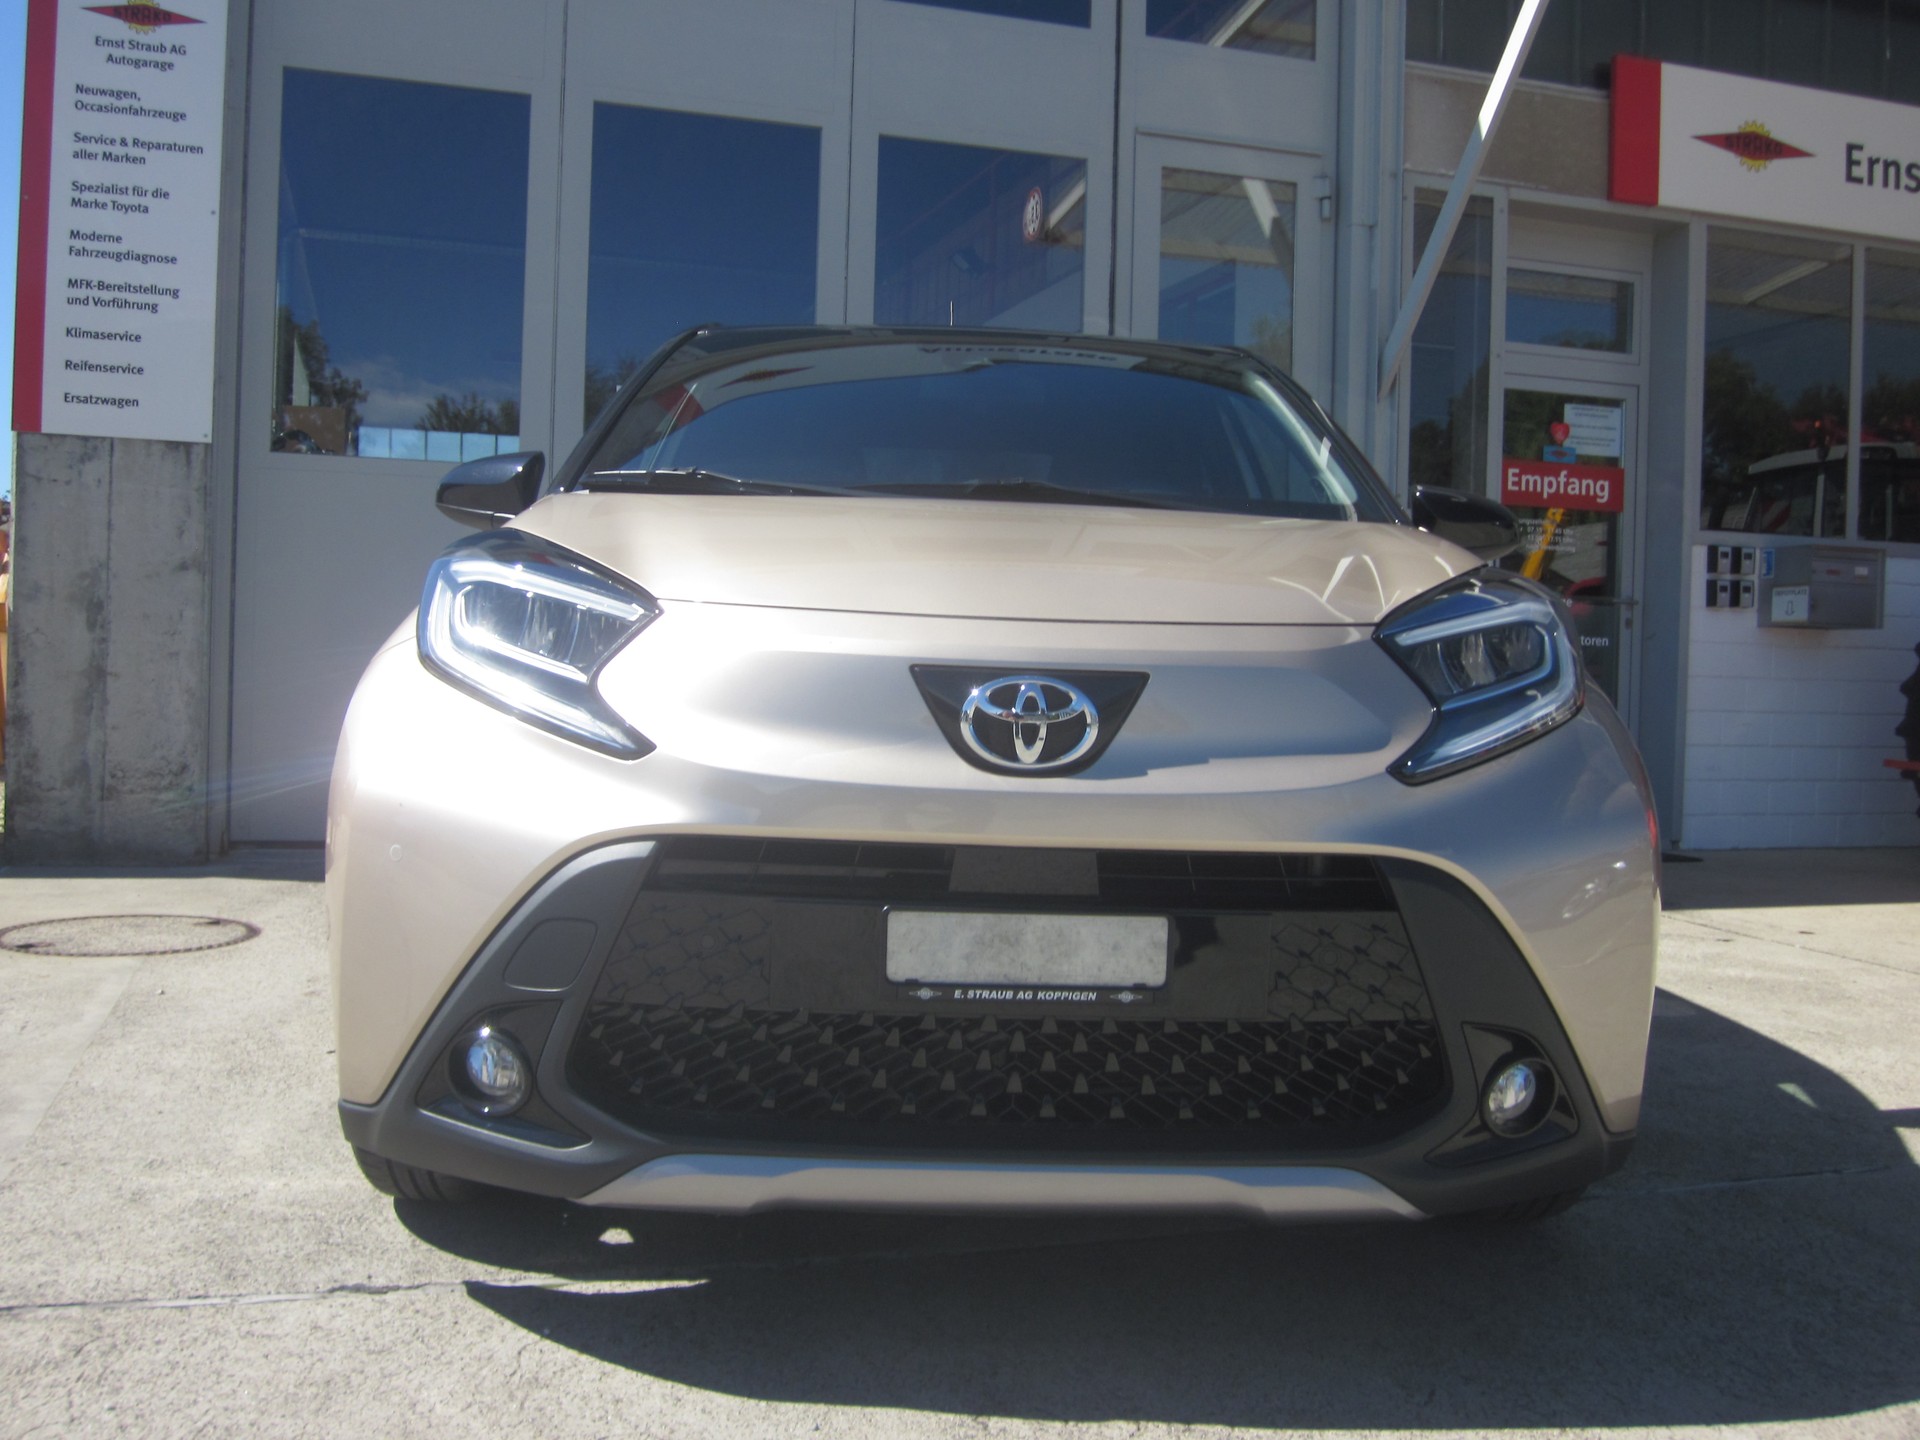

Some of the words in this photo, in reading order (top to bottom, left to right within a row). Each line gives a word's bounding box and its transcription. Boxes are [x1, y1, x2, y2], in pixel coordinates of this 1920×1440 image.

[95, 36, 125, 50] Ernst
[128, 40, 167, 54] Straub
[170, 45, 187, 56] AG
[106, 54, 175, 71] Autogarage
[75, 84, 141, 102] Neuwagen,
[74, 101, 187, 122] Occasionfahrzeuge
[73, 132, 117, 148] Service
[120, 137, 129, 148] &
[132, 138, 204, 155] Reparaturen
[72, 150, 99, 162] aller
[102, 152, 146, 165] Marken
[71, 181, 129, 197] Spezialist
[132, 184, 148, 198] für
[152, 188, 170, 200] die
[71, 198, 108, 211] Marke
[110, 200, 149, 215] Toyota
[69, 229, 123, 244] Moderne
[69, 246, 178, 265] Fahrzeugdiagnose
[67, 278, 180, 299] MFK-Bereitstellung
[67, 296, 90, 307] und
[92, 297, 159, 314] Vorführung
[65, 327, 142, 343] Klimaservice
[64, 360, 144, 375] Reifenservice
[63, 393, 139, 408] Ersatzwagen
[1507, 468, 1610, 503] Empfang
[954, 989, 965, 999] E.
[967, 989, 1014, 999] STRAUB
[1016, 991, 1033, 1000] AG
[1037, 991, 1097, 1001] KOPPIGEN
